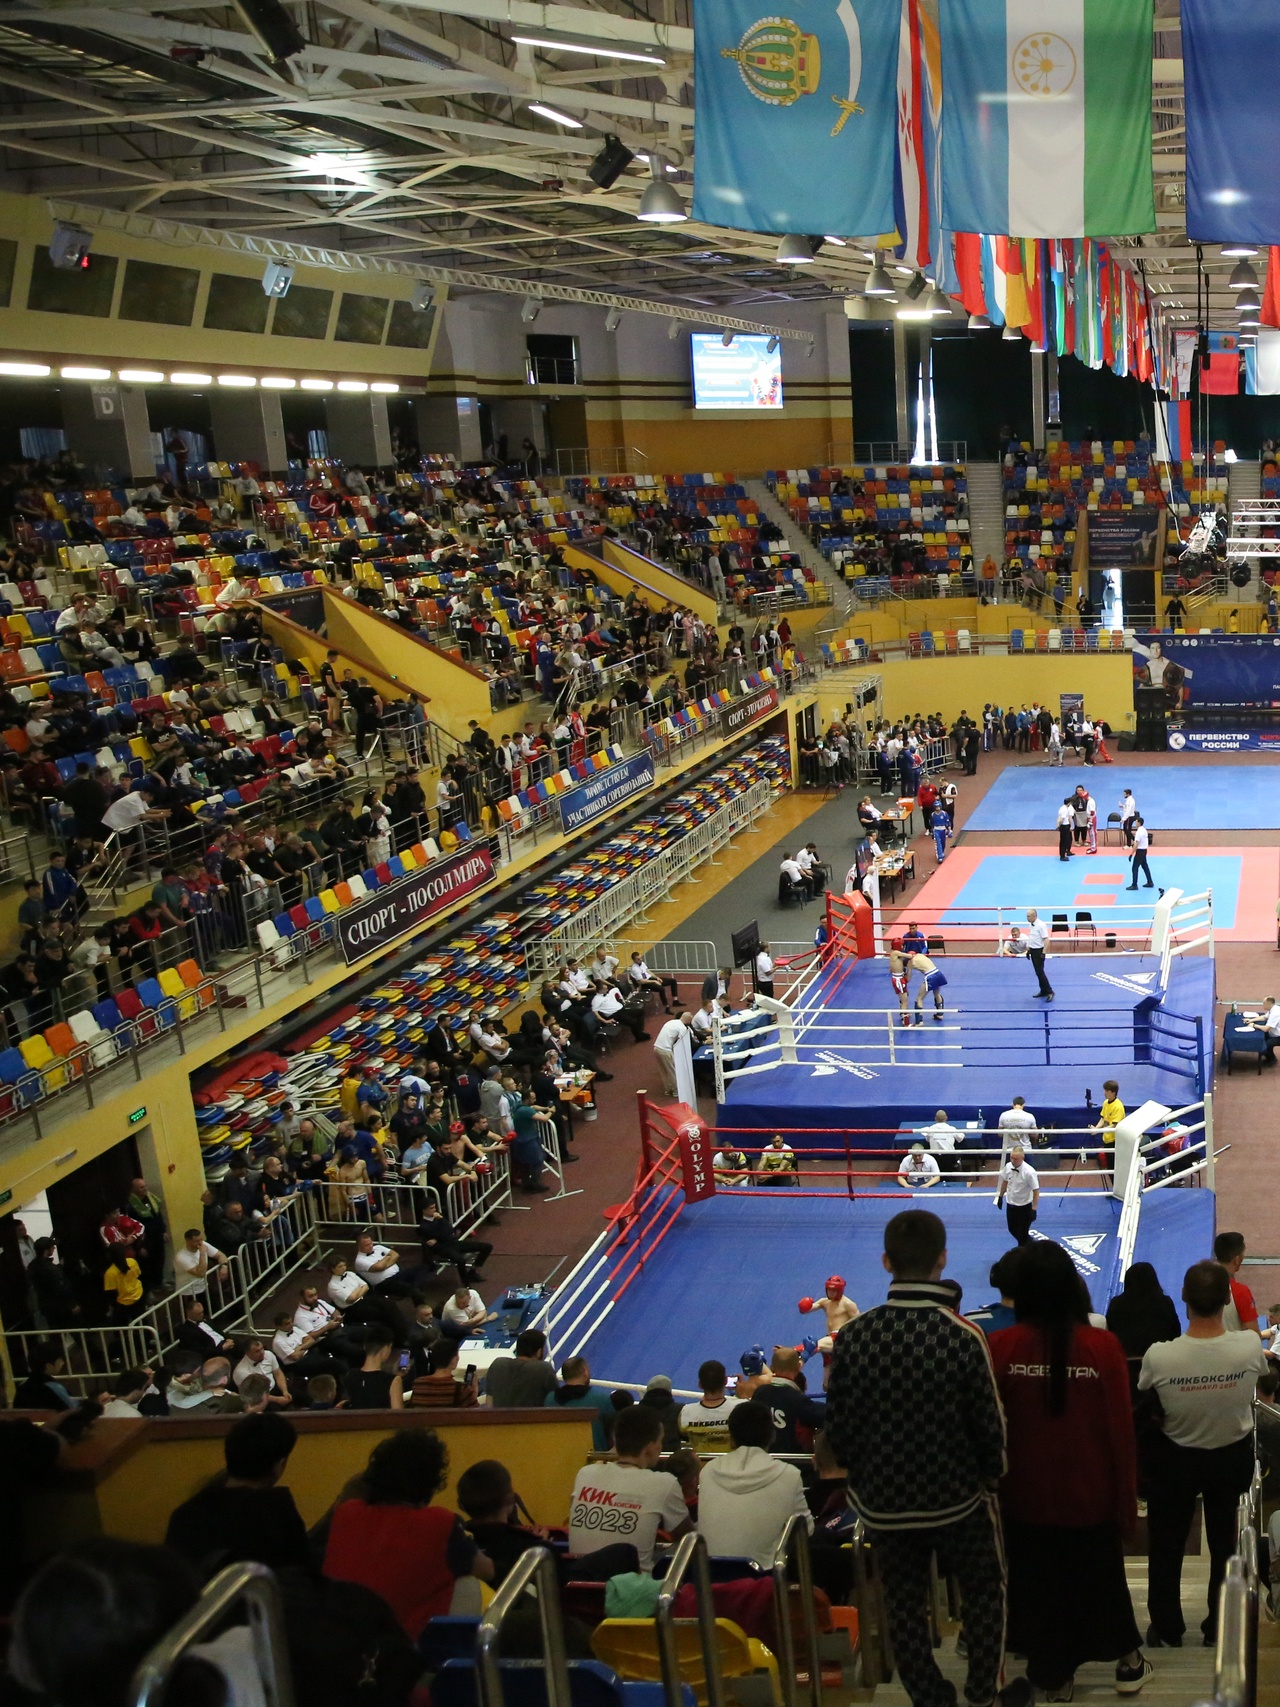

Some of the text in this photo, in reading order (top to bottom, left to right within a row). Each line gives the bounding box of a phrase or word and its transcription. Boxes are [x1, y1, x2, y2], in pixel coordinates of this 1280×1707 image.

[100, 396, 114, 414] D
[567, 796, 608, 826] УЧАСТНИКОВ
[348, 902, 397, 945] СПОРТ
[407, 873, 454, 914] ПОСОЛ
[454, 855, 487, 886] МИРА
[690, 1143, 705, 1193] OLYMP
[1007, 1363, 1099, 1379] DAGETAN
[1169, 1371, 1246, 1385] КИКБОКСИНГ
[1180, 1384, 1218, 1392] БАРНАУЛ
[571, 1504, 638, 1534] 2023
